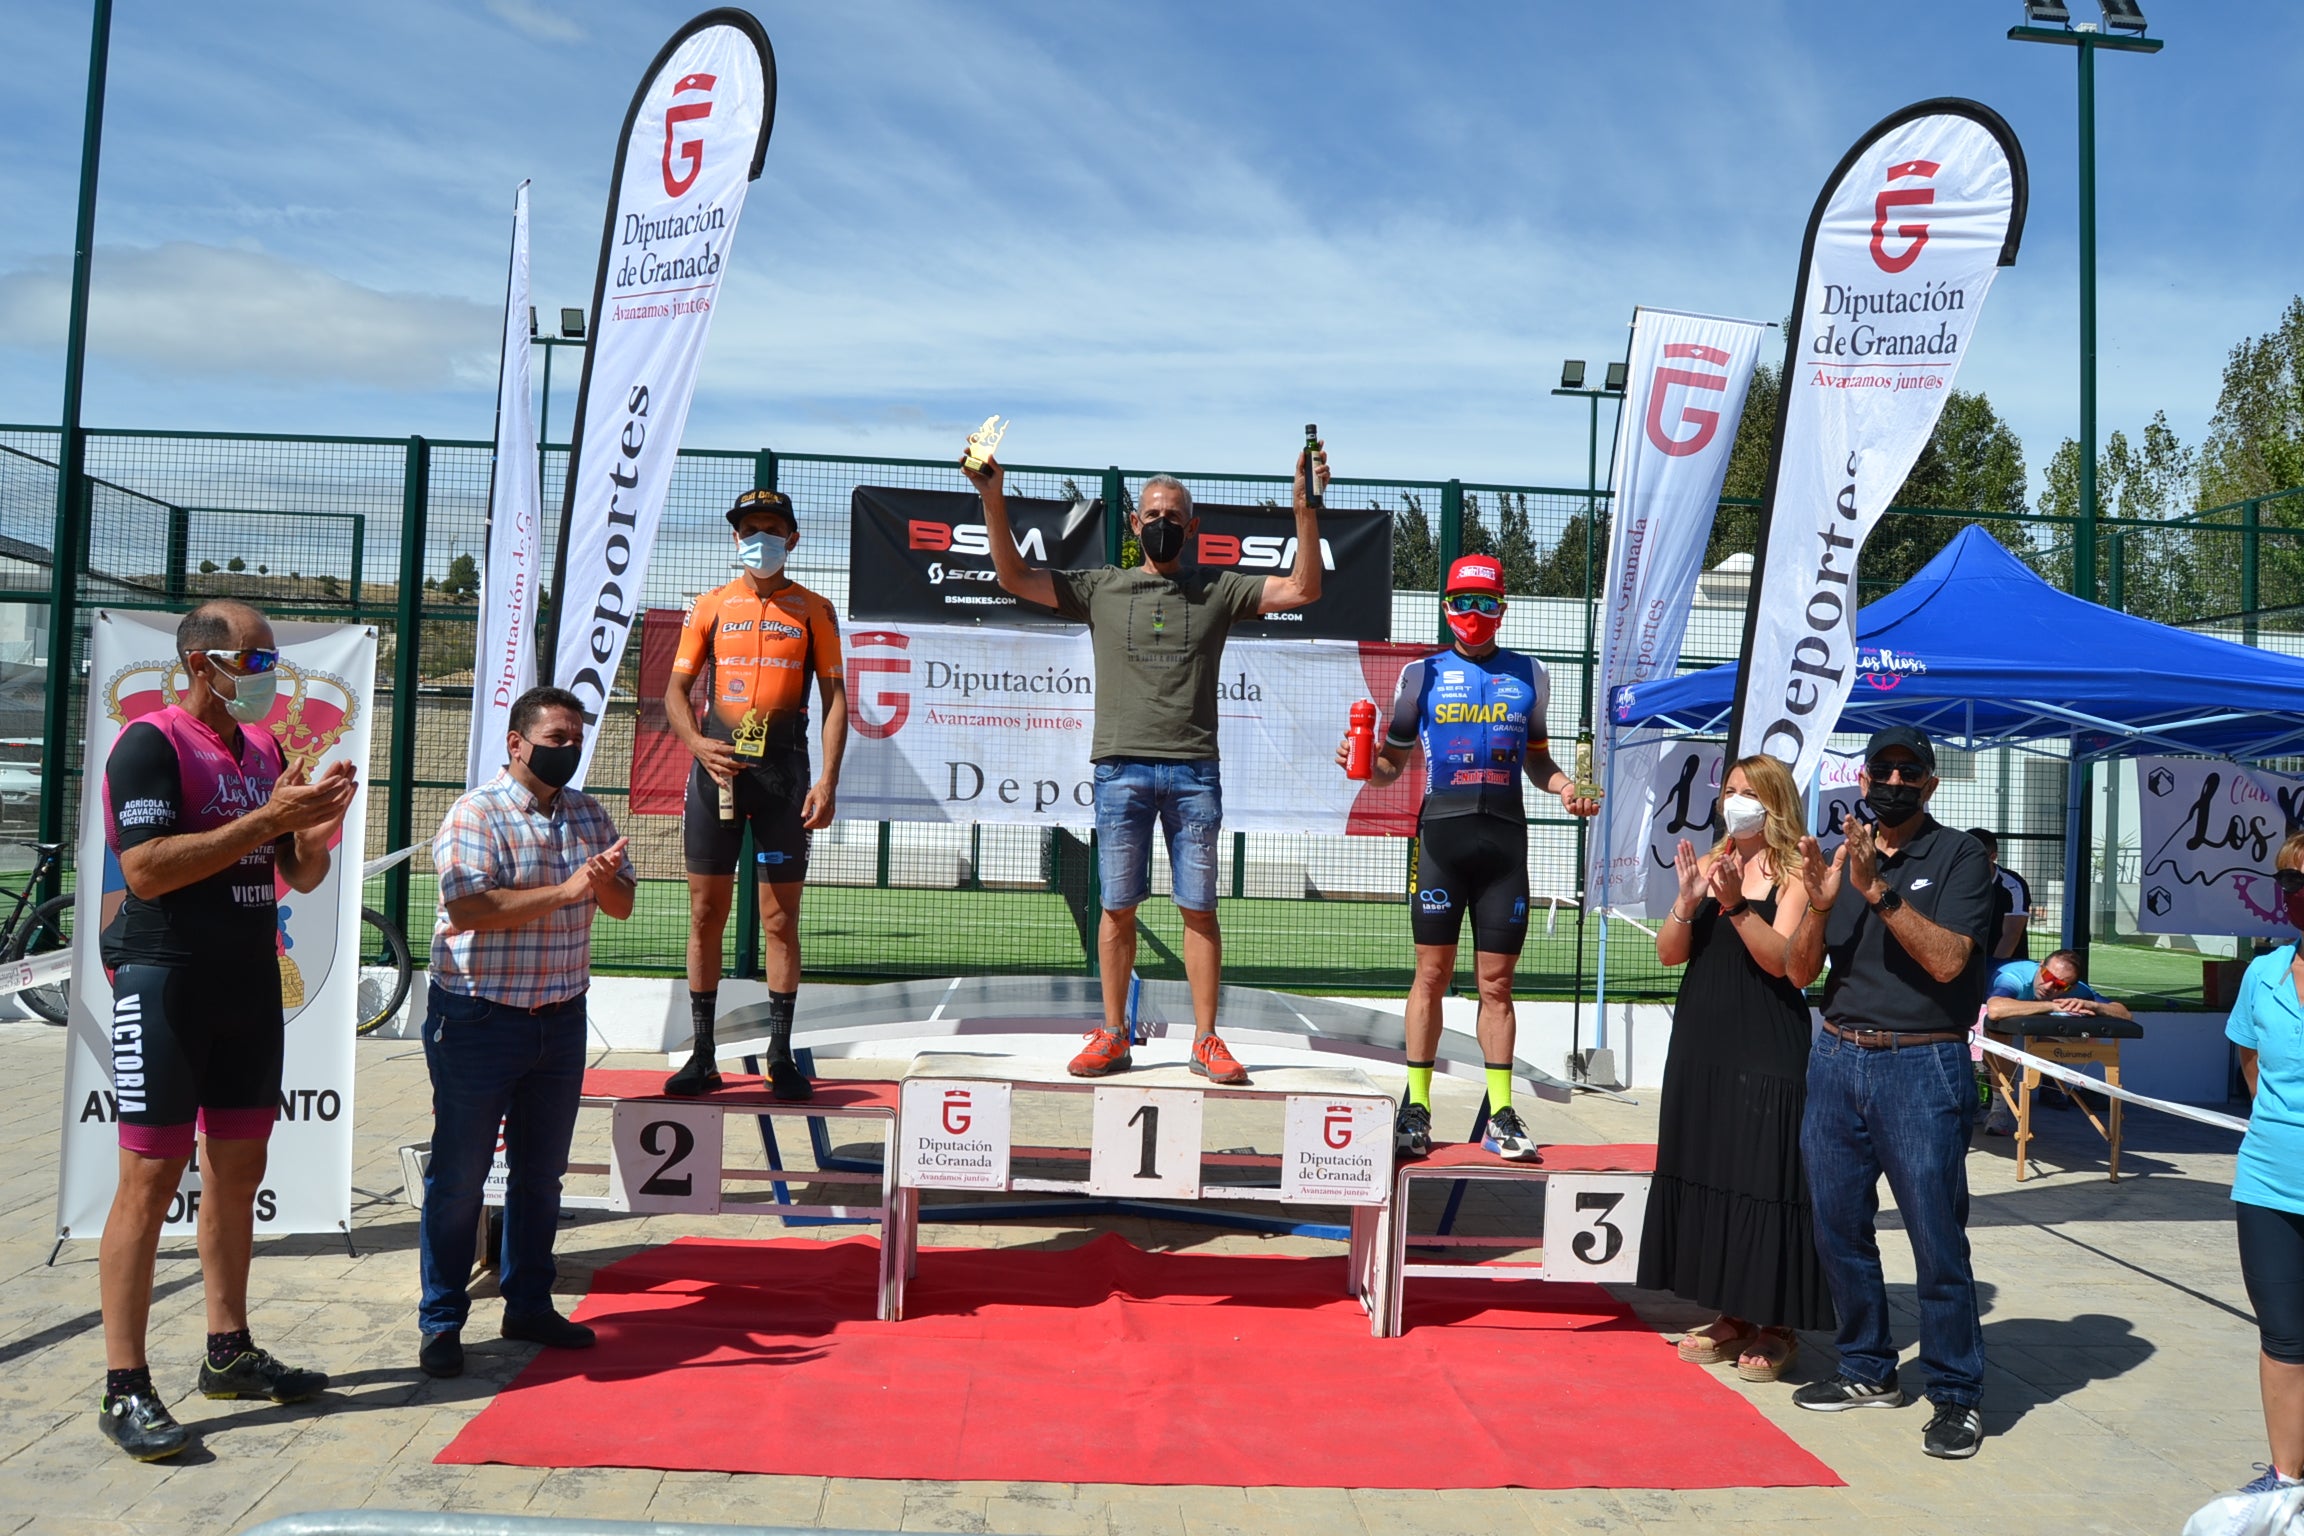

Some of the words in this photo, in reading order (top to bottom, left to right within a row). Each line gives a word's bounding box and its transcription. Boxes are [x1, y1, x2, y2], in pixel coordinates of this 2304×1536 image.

[622, 201, 726, 251] Diputación
[615, 254, 638, 289] de
[639, 241, 721, 285] Granada
[611, 302, 670, 322] Avanzamos
[1819, 280, 1965, 323] Diputación
[1812, 322, 1847, 357] de
[1850, 320, 1958, 358] Granada
[1893, 371, 1944, 393] junt@s
[569, 384, 651, 728] Deportes
[908, 519, 1048, 562] BSM
[1197, 533, 1336, 571] BSM
[944, 594, 1017, 606] BSMBIKES.COM
[492, 572, 526, 710] Diputación
[721, 620, 753, 634] Bull
[759, 620, 803, 637] Bikes
[1628, 598, 1665, 686] eportes
[924, 659, 1093, 698] Diputación
[924, 707, 1021, 729] Avanzamos
[1024, 712, 1083, 732] junt@s
[1434, 702, 1508, 724] SEMAR
[119, 807, 177, 821] EXCAVACIONES
[124, 797, 165, 810] AGRÍCOLA
[114, 993, 147, 1114] VICTORIA
[638, 1120, 695, 1197] 2
[917, 1152, 933, 1166] de
[935, 1152, 992, 1168] Granada
[918, 1137, 993, 1153] Diputación
[1126, 1104, 1163, 1179] 1
[1300, 1151, 1373, 1168] Diputación
[1298, 1166, 1314, 1180] de
[1316, 1167, 1372, 1182] Granada
[1571, 1192, 1627, 1266] 3
